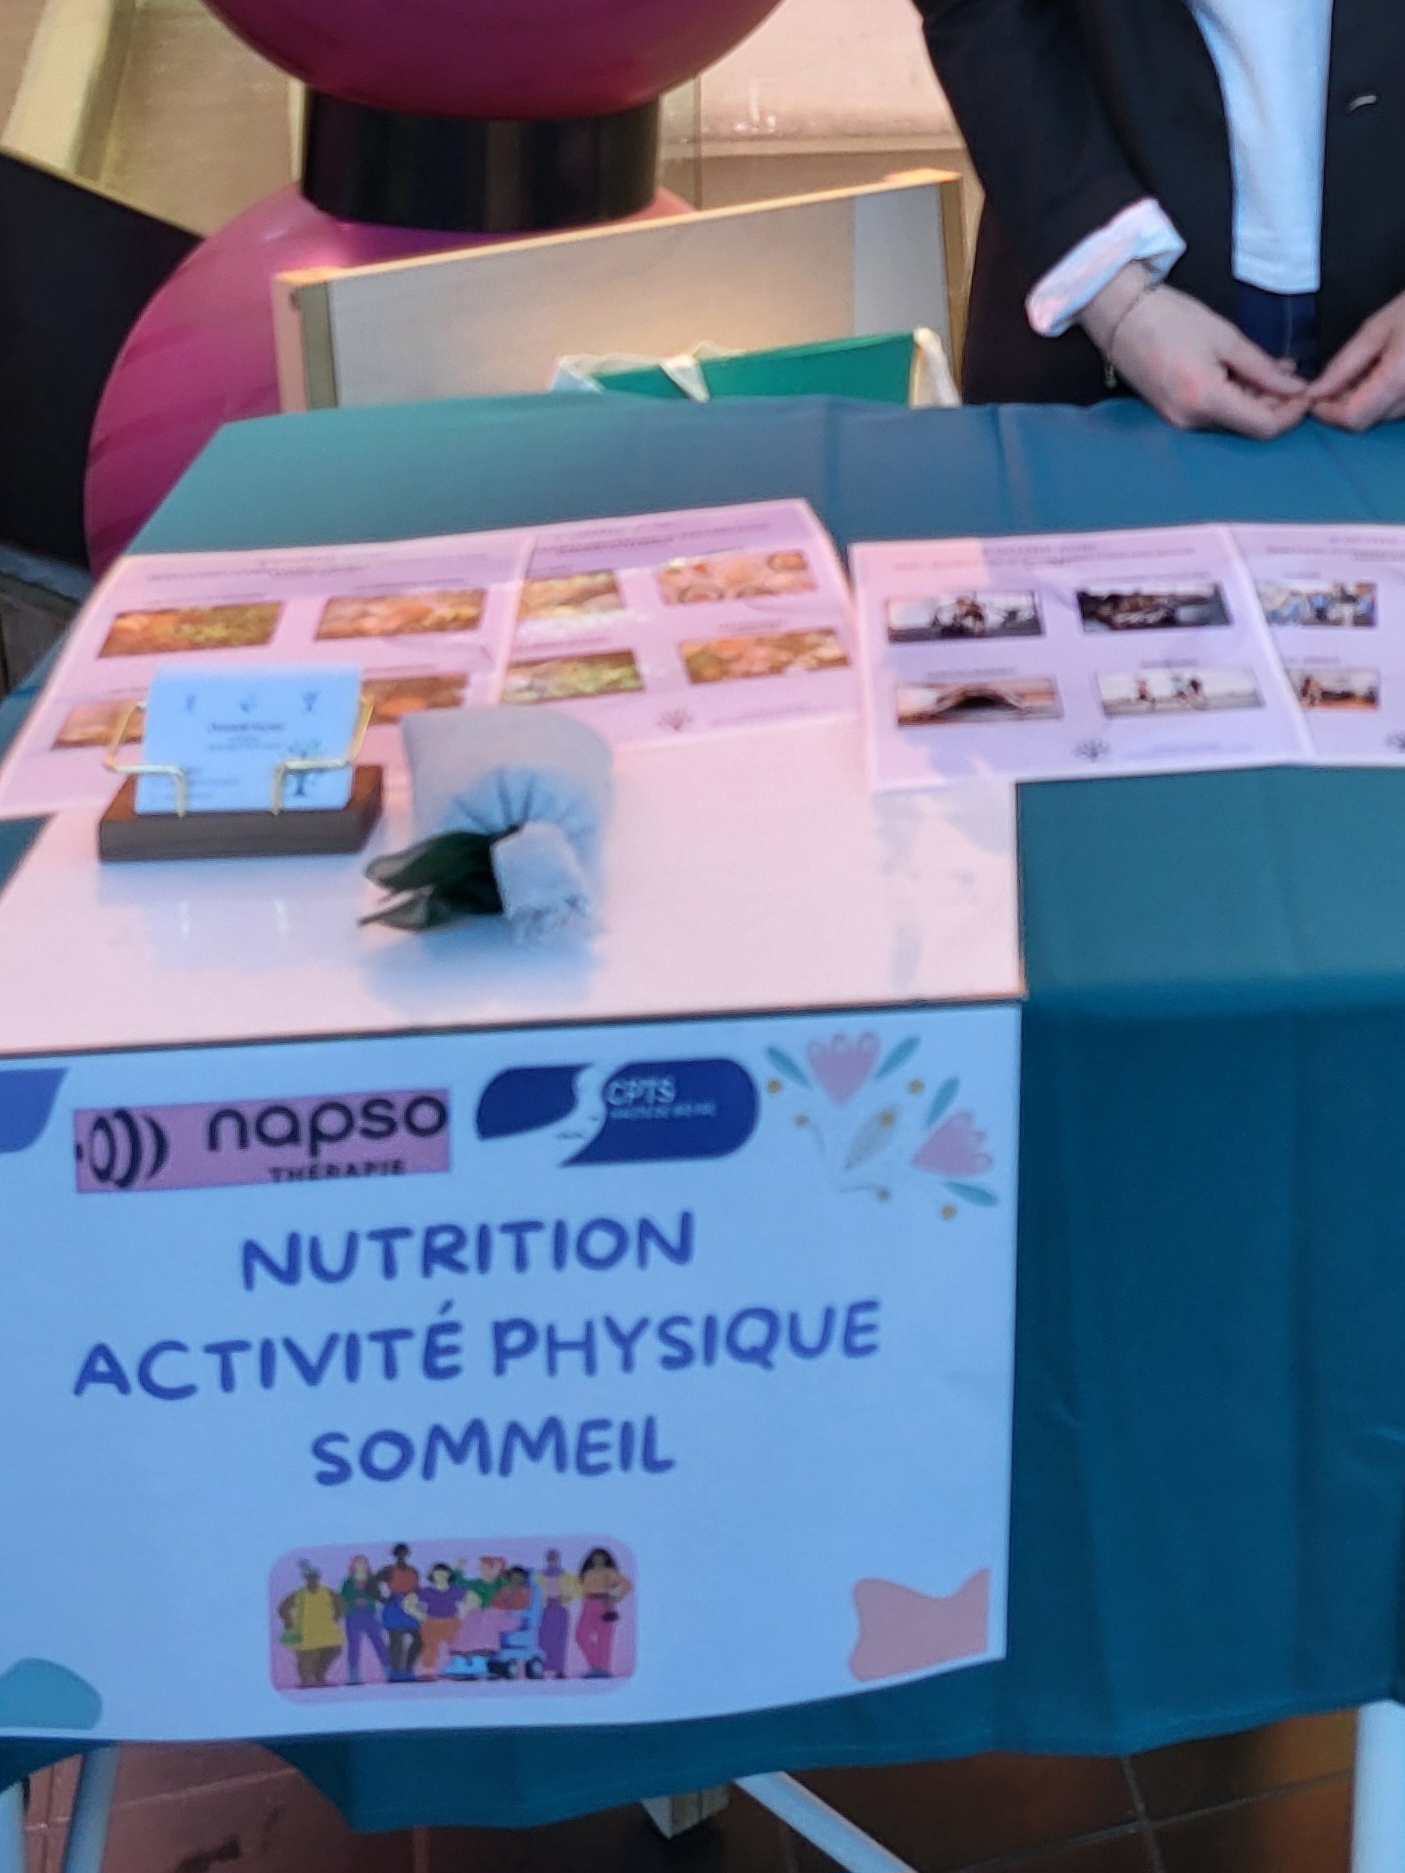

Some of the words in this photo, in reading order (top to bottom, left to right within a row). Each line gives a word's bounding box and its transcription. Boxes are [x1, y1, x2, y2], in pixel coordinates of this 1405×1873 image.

[205, 1094, 454, 1160] napso
[605, 1074, 676, 1106] CPTS
[240, 1207, 696, 1293] NUTRITION
[71, 1297, 464, 1403] ACTIVITÉ
[488, 1298, 882, 1378] PHYSIQUE
[309, 1414, 677, 1488] SOMMEIL
